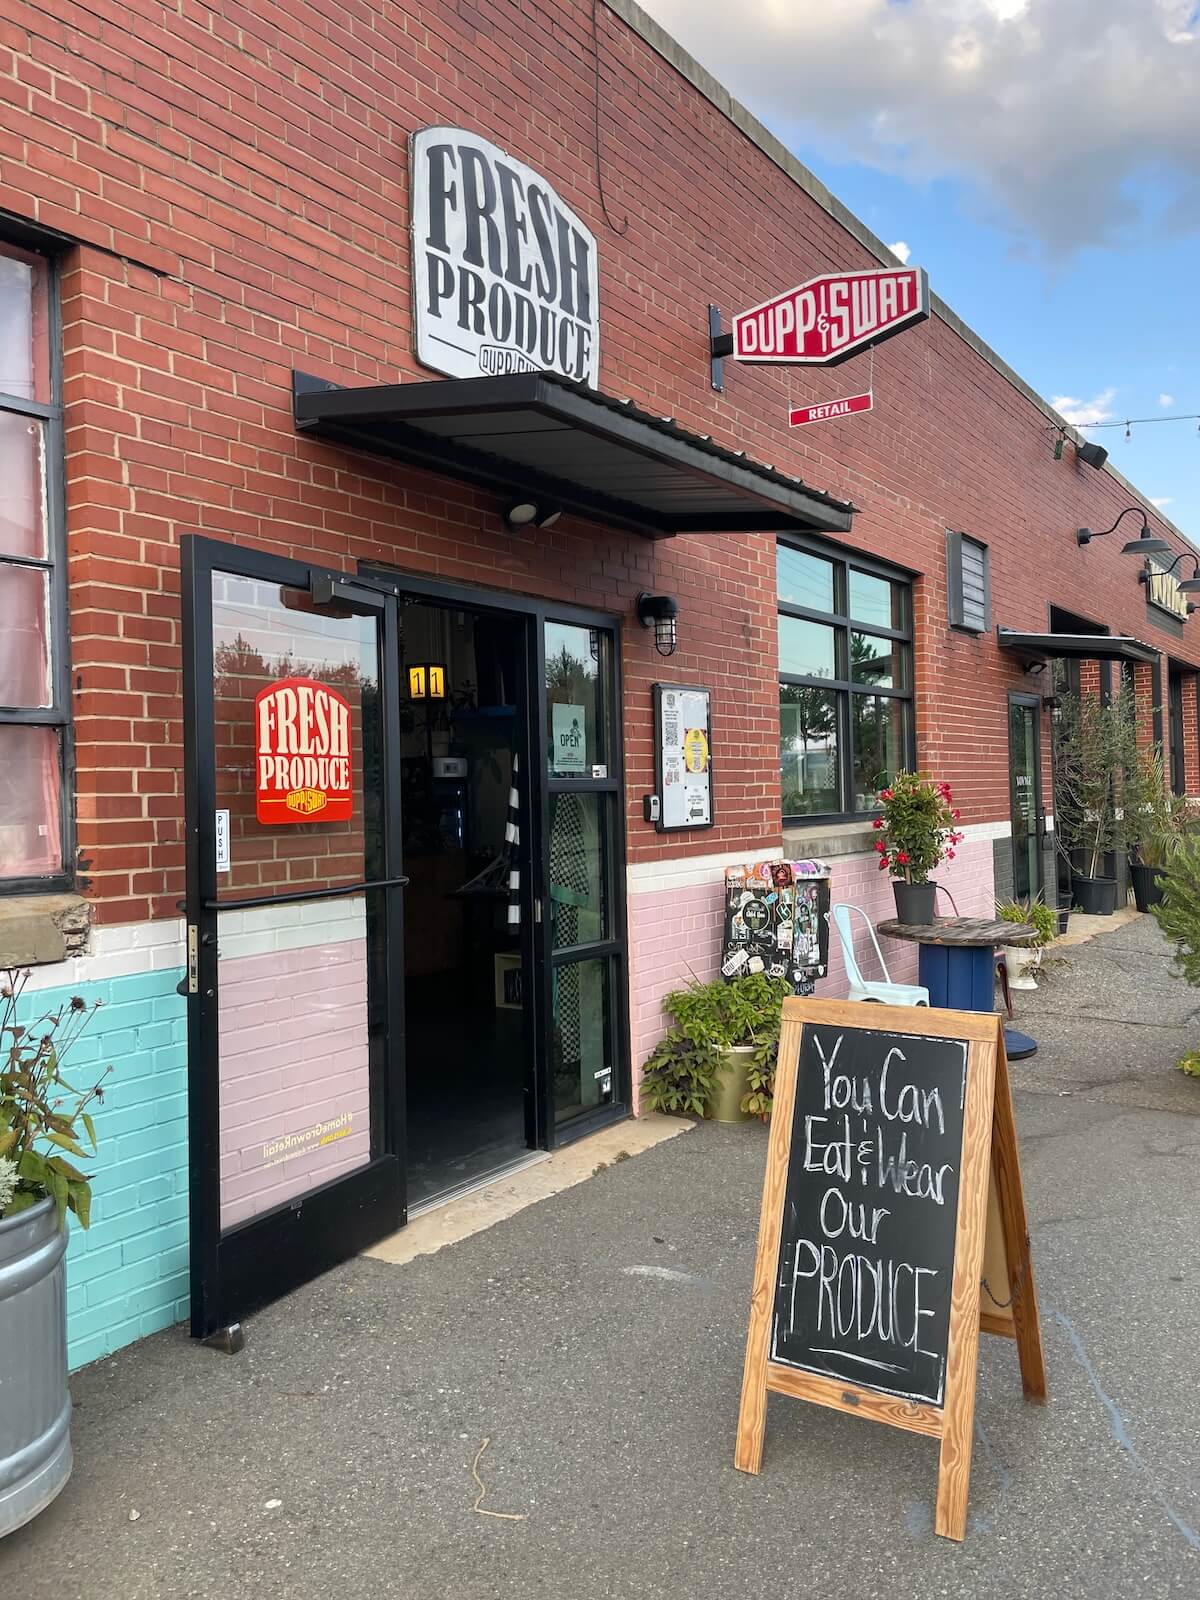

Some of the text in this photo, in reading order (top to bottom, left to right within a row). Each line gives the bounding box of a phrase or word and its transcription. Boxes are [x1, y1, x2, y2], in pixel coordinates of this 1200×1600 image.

[426, 144, 592, 325] FRESH
[426, 251, 592, 380] PRODUCE
[808, 401, 851, 420] RETAIL
[258, 686, 349, 756] FRESH
[560, 734, 579, 747] OPEN
[259, 756, 349, 790] PRODUCE
[813, 1034, 945, 1134] You Can
[804, 1114, 856, 1183] Eat
[877, 1125, 954, 1205] Wear
[820, 1187, 891, 1245] Our
[790, 1239, 940, 1358] PRODUCE
